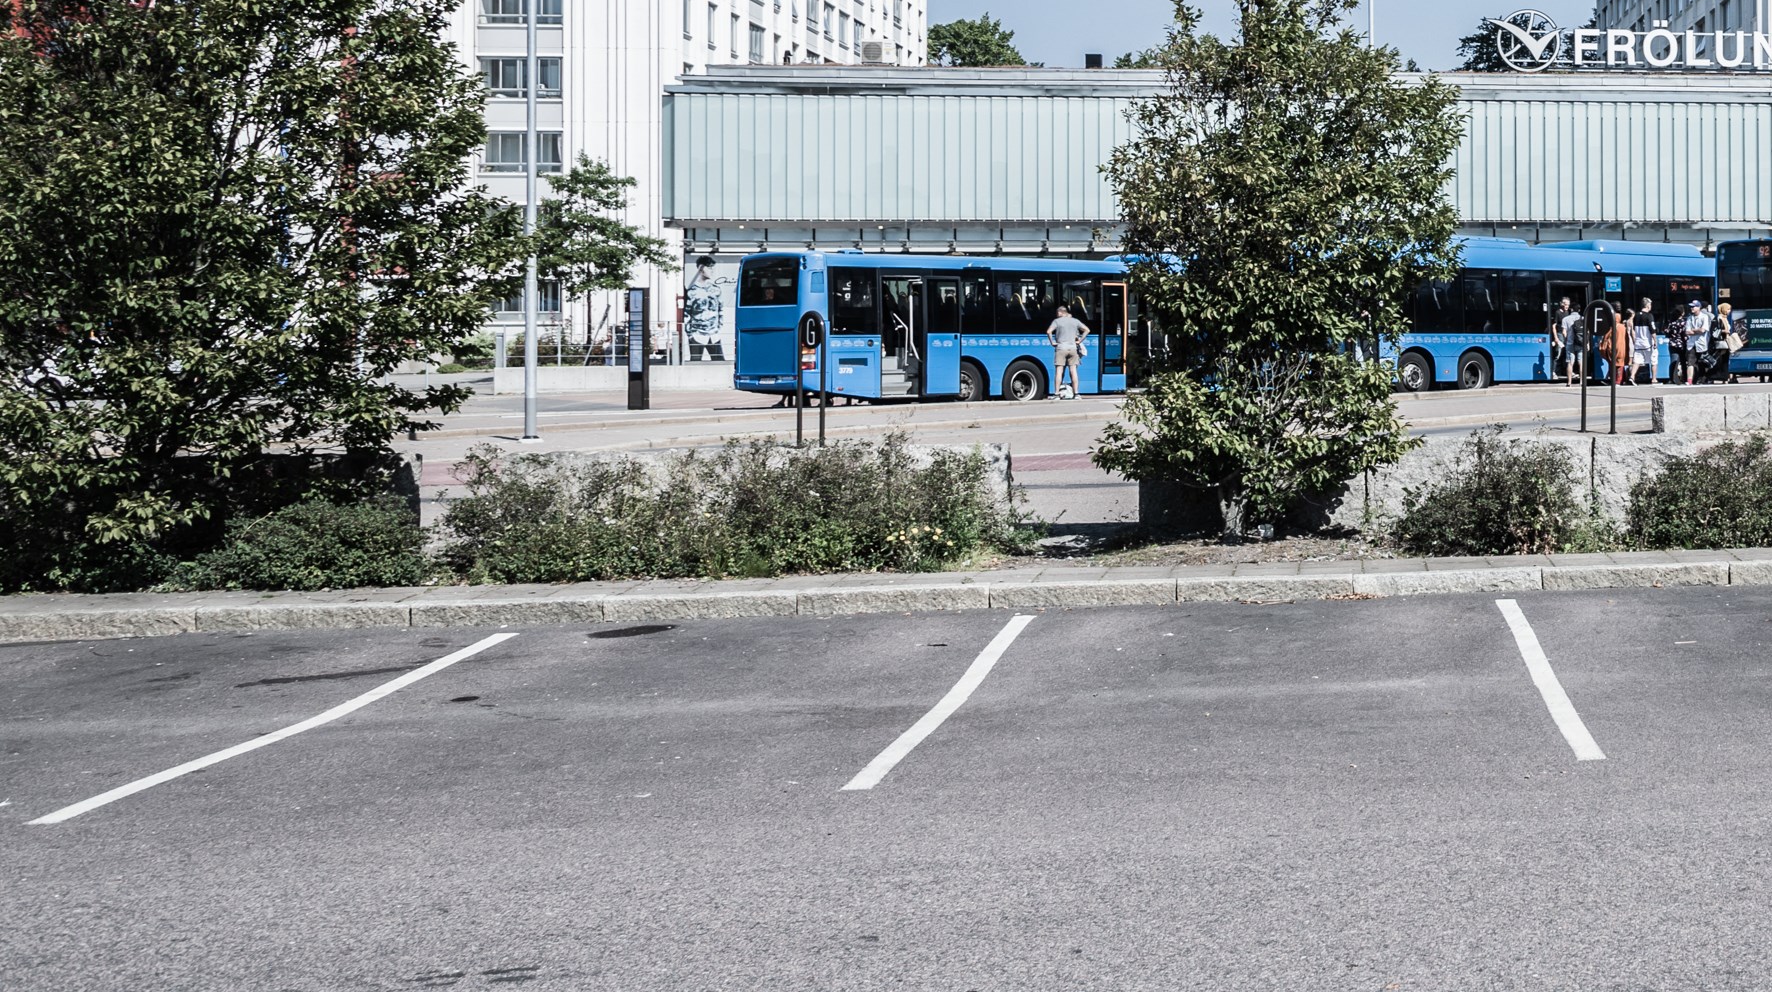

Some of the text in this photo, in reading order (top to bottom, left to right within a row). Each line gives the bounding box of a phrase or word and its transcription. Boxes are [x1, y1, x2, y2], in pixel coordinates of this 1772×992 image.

[1759, 246, 1770, 256] 92
[806, 318, 816, 346] G
[1594, 307, 1604, 333] F
